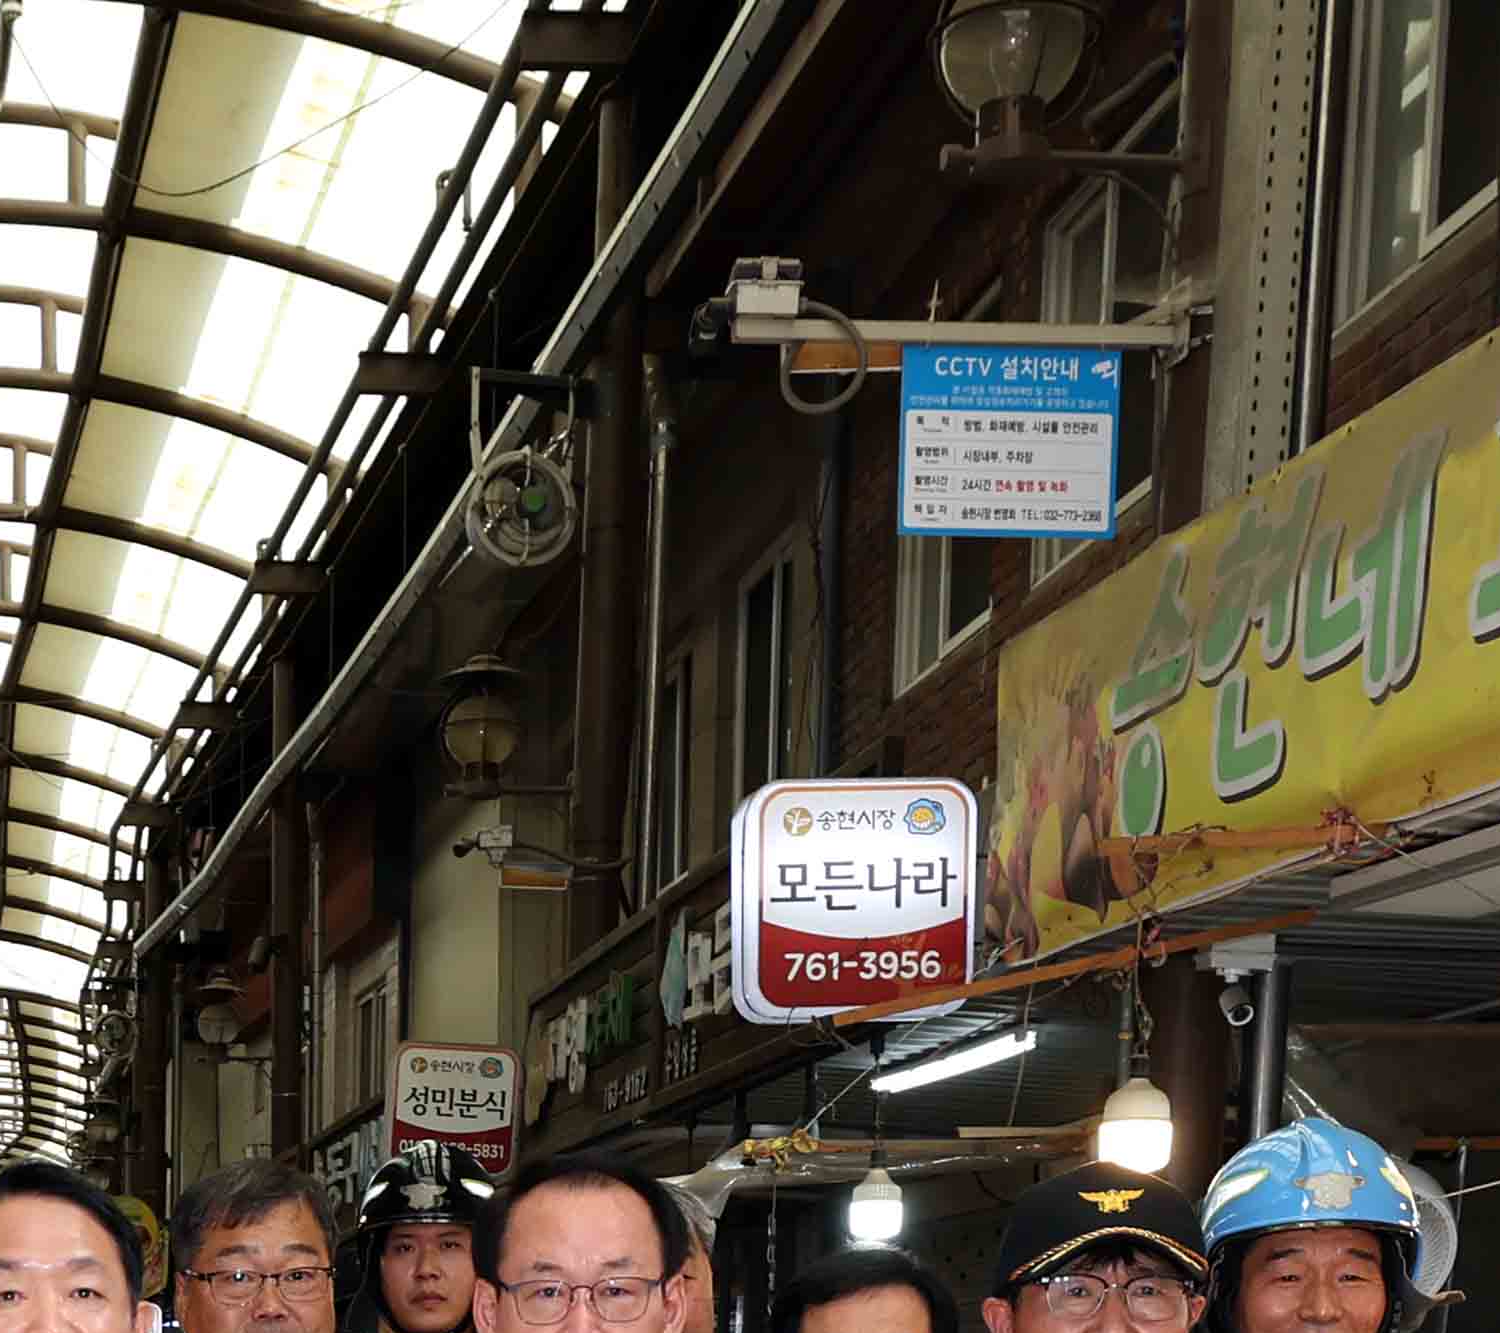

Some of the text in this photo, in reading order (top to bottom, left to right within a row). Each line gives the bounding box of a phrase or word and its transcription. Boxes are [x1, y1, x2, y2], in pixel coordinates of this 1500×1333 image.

[935, 356, 1080, 381] CCTV 설치안내
[961, 479, 992, 493] 24시간
[1108, 425, 1450, 838] 송현네
[816, 807, 897, 833] 송현시장
[769, 856, 957, 911] 모든나라
[784, 948, 942, 982] 761-3956
[403, 1085, 507, 1121] 성민분식
